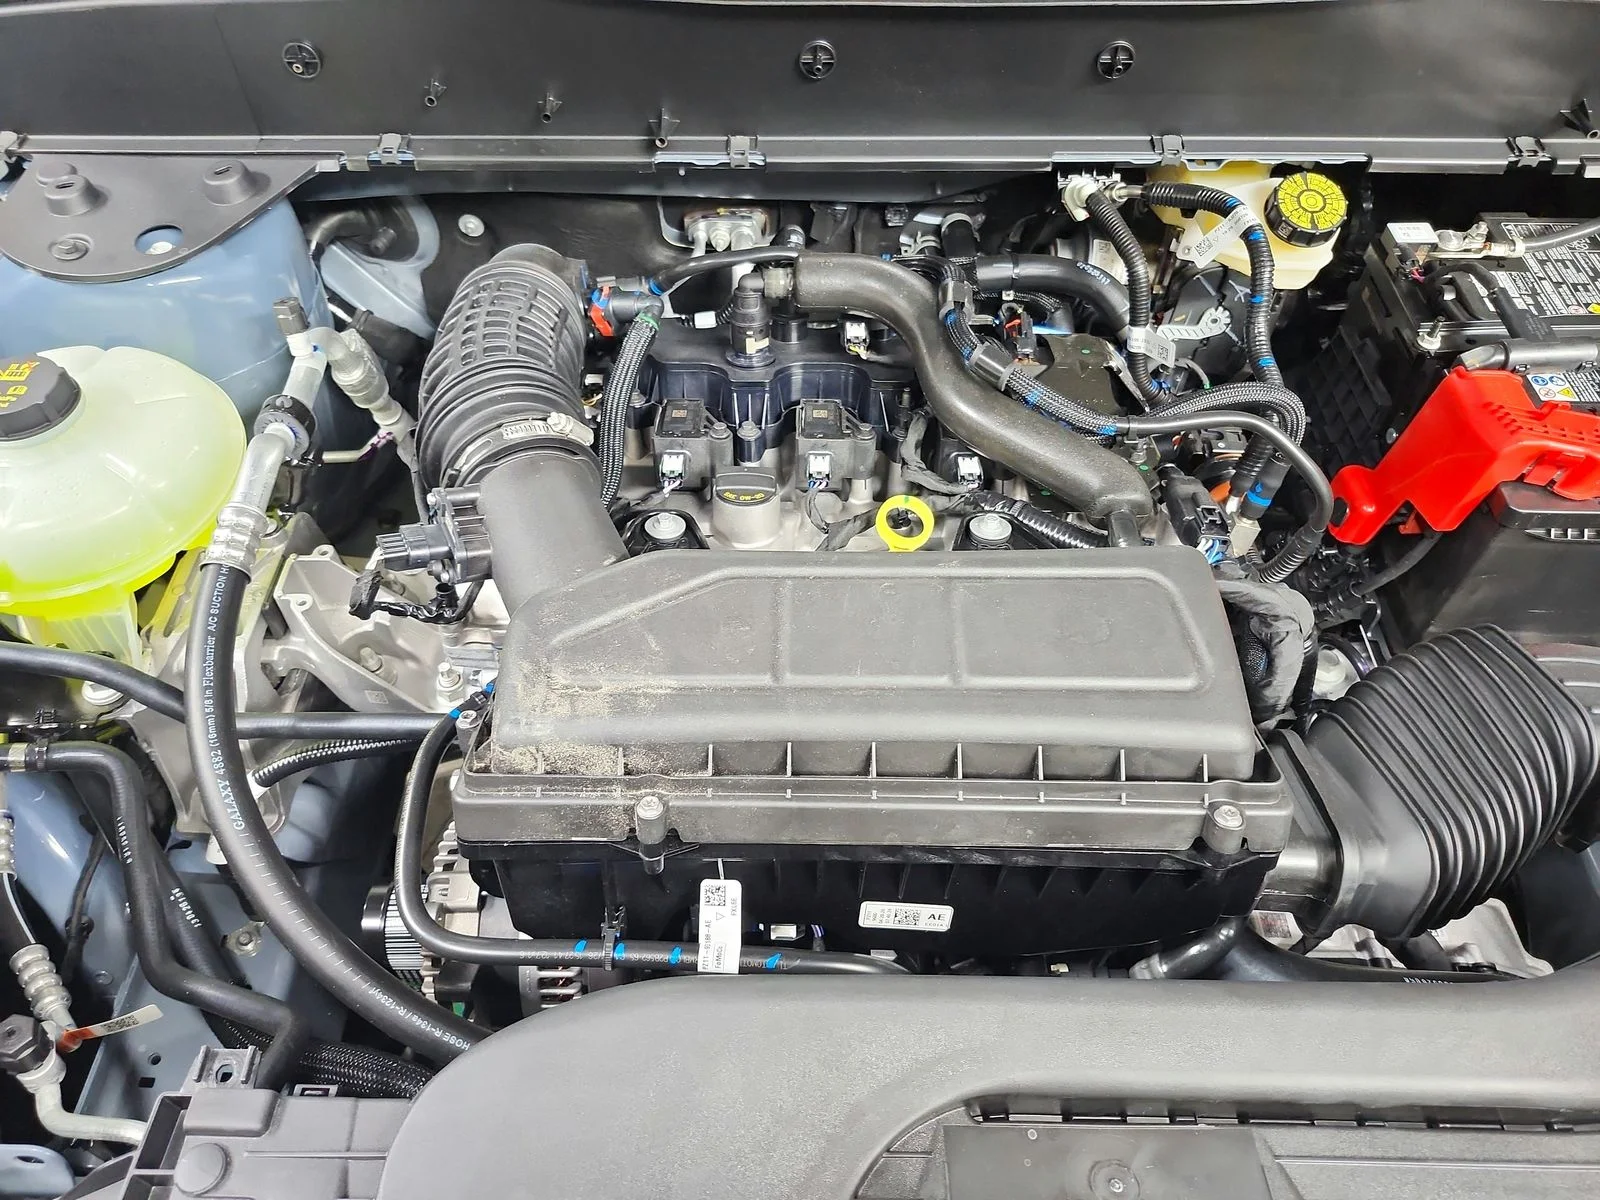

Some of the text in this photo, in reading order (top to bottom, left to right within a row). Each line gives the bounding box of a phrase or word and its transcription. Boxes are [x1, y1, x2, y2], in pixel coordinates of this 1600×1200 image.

[210, 575, 227, 614] SUCTION
[207, 616, 217, 631] A/C
[202, 636, 215, 687] Flexbarrier
[206, 714, 220, 747] (16mm)
[210, 750, 225, 775] 4882
[217, 779, 245, 830] GALAXY
[928, 913, 946, 921] AE
[368, 987, 407, 1016] R-1234yf
[412, 1015, 443, 1037] R-134a
[443, 1032, 471, 1051] HOSE
